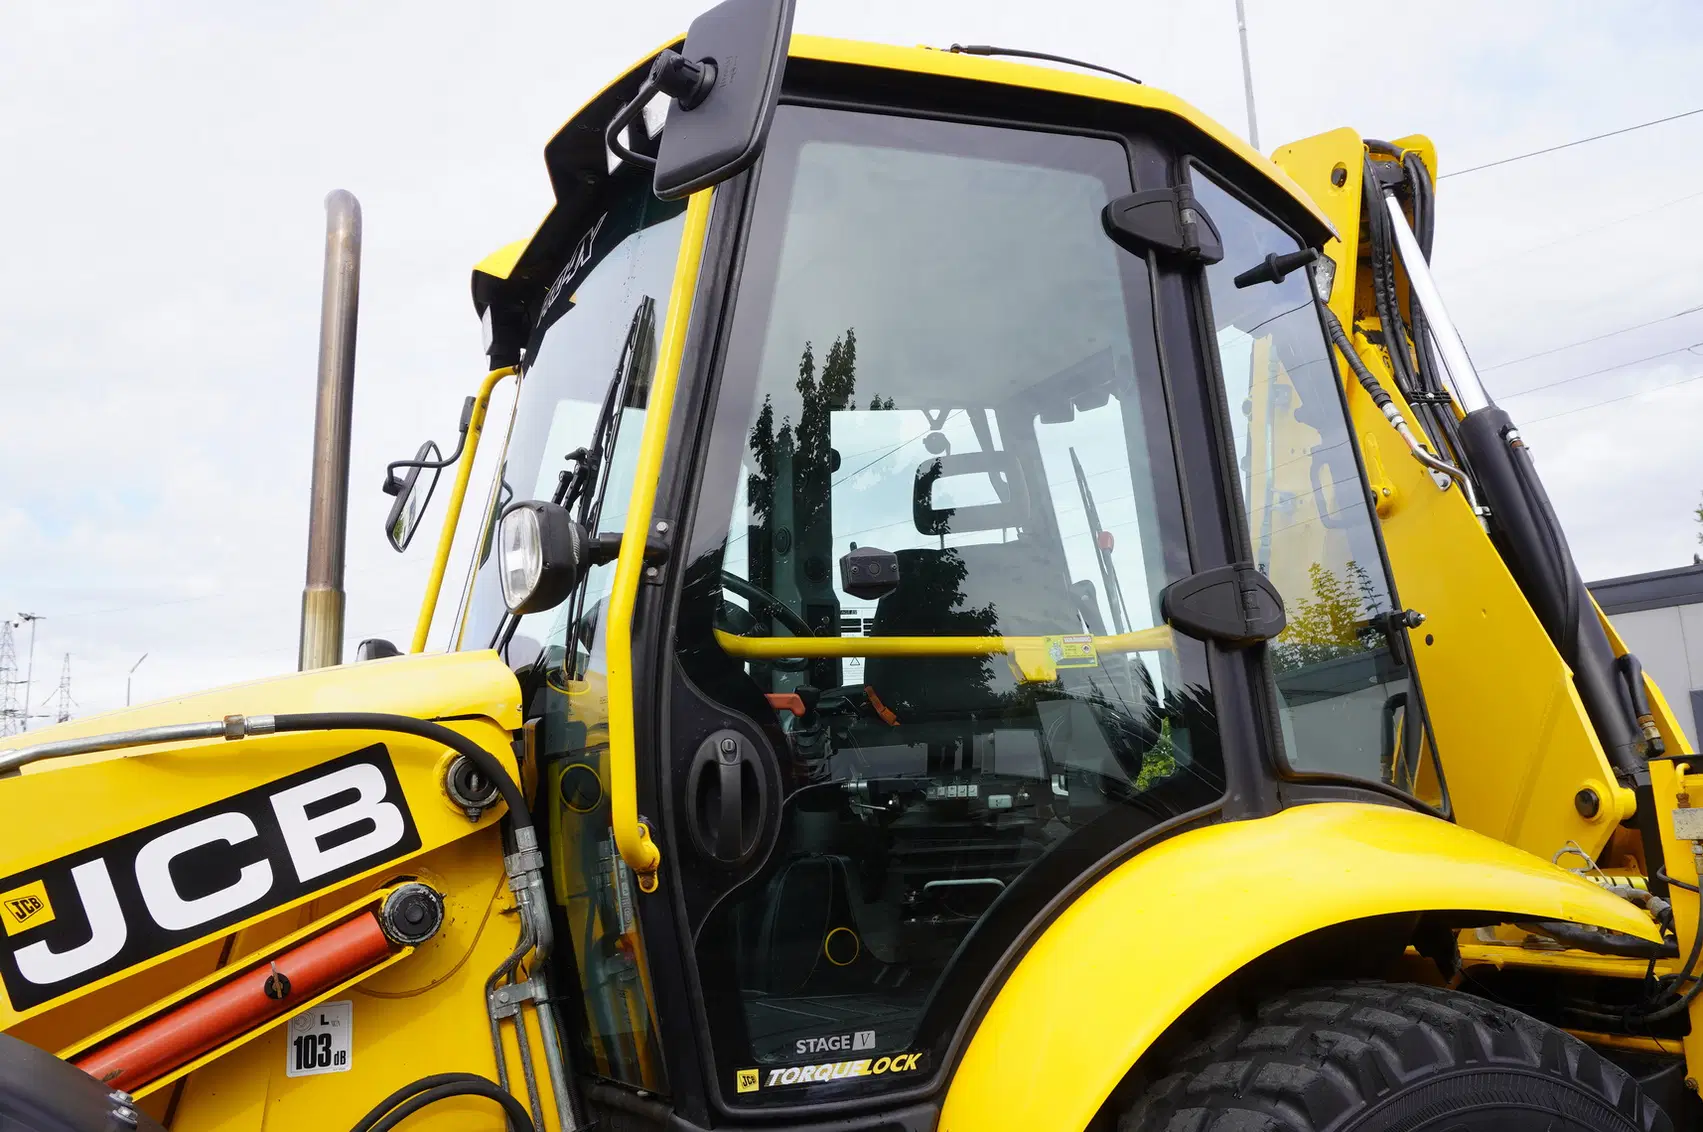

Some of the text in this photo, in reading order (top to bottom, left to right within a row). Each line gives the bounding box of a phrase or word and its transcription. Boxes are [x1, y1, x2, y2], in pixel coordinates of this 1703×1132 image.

[13, 762, 405, 985] JCB
[11, 897, 42, 920] JCB
[293, 1033, 347, 1070] 103 dB
[796, 1035, 851, 1054] STAGE
[742, 1074, 757, 1088] JCB
